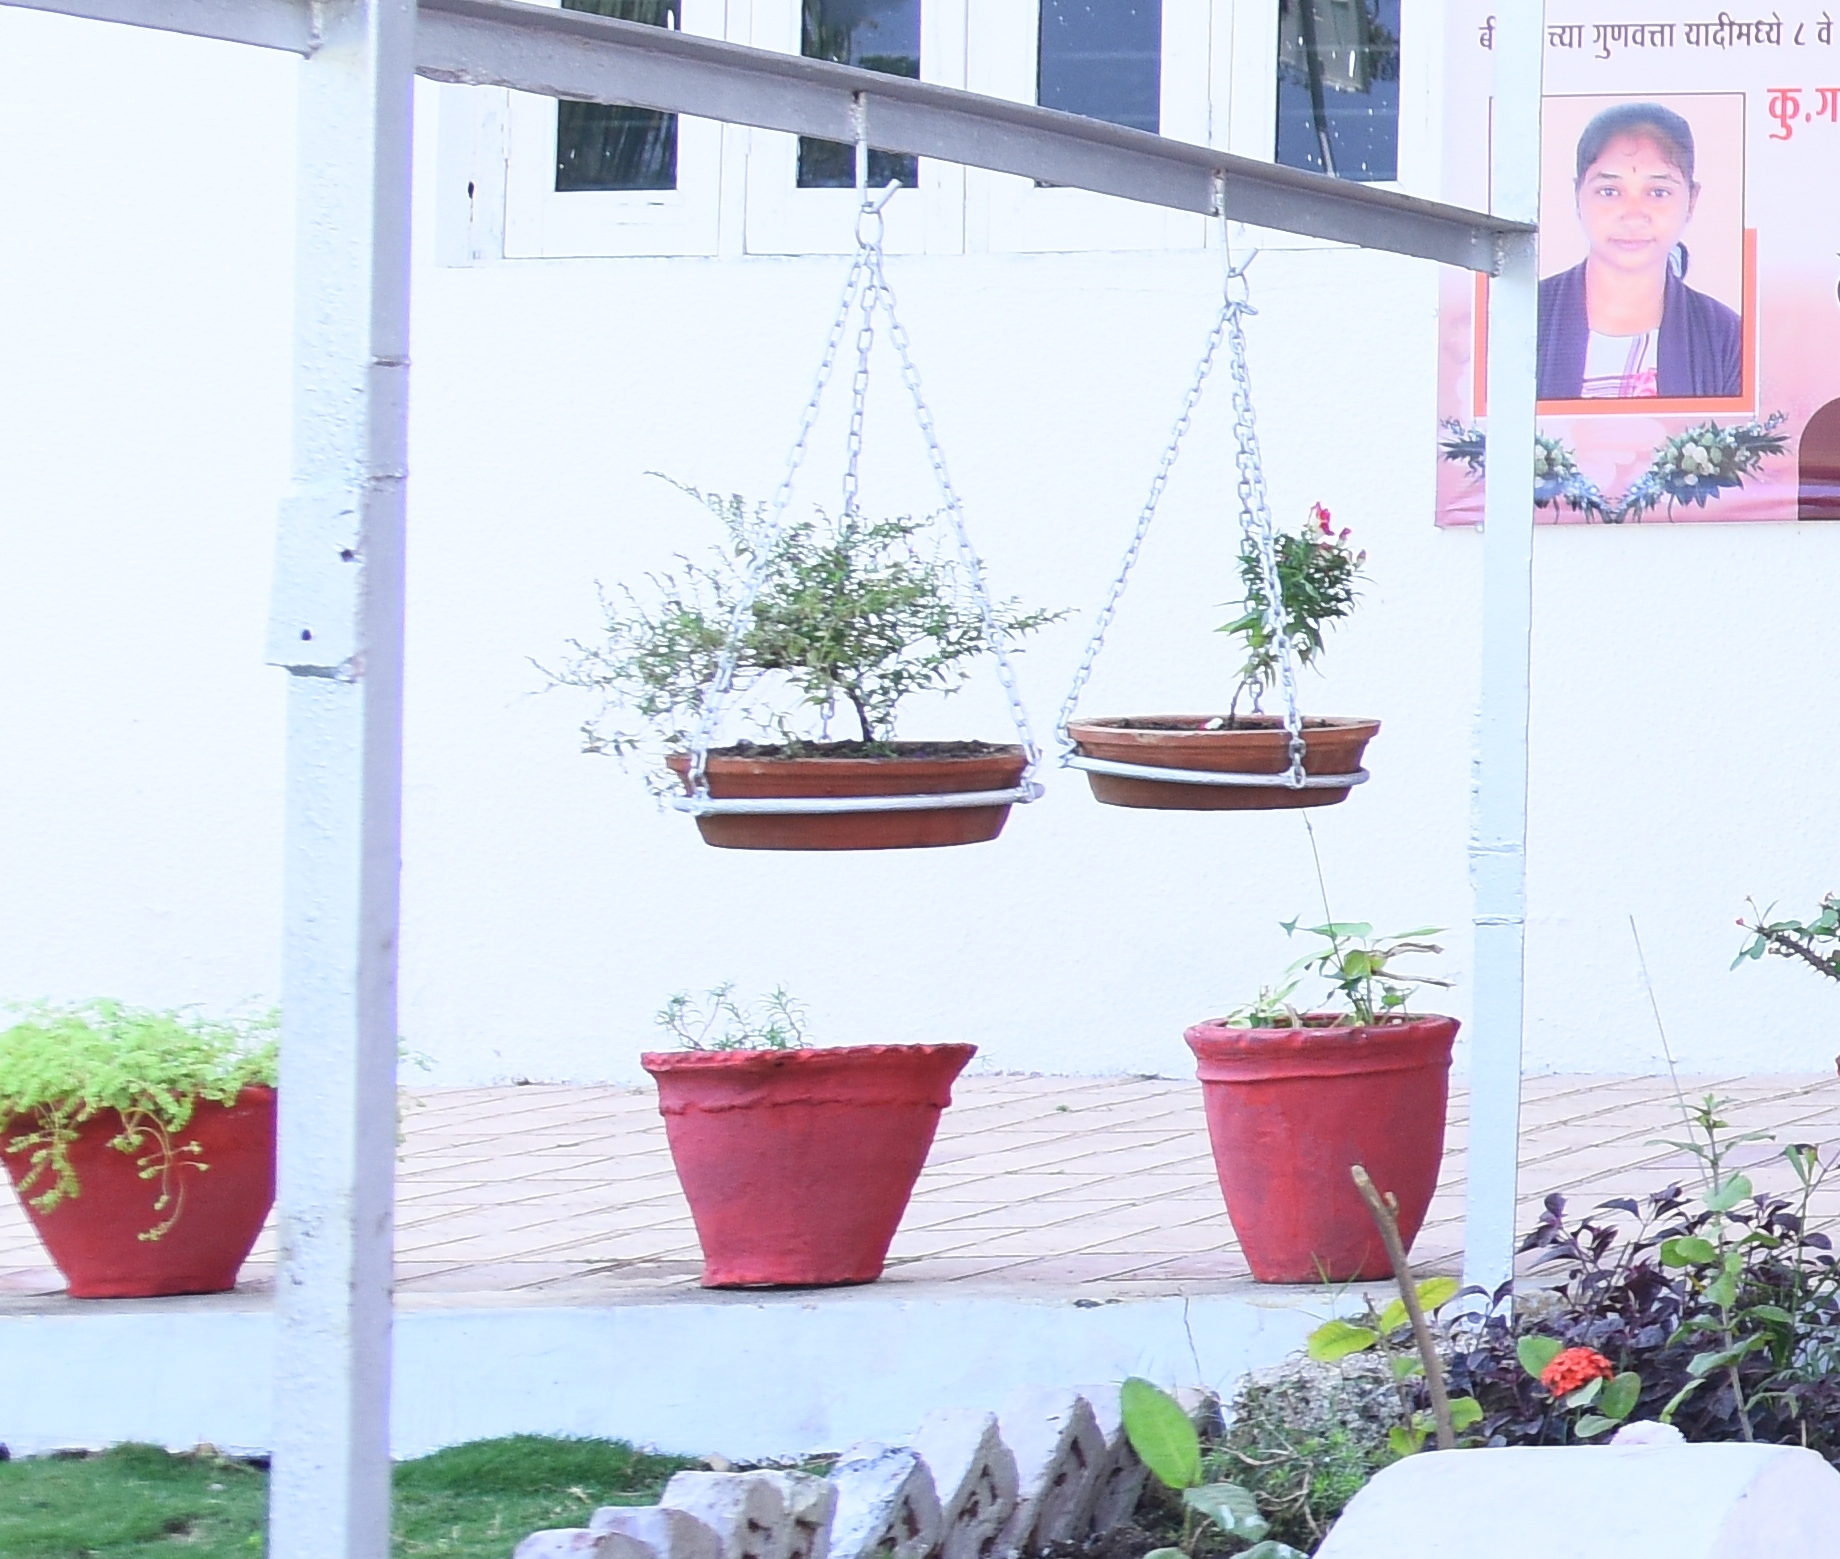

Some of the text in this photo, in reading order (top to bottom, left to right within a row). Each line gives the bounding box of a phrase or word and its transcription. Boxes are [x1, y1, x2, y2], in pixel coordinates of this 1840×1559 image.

[1593, 22, 1677, 59] गुणवत्ता
[1684, 11, 1783, 50] यादीमध्ये
[1793, 24, 1806, 46] ८
[1817, 11, 1833, 46] वे
